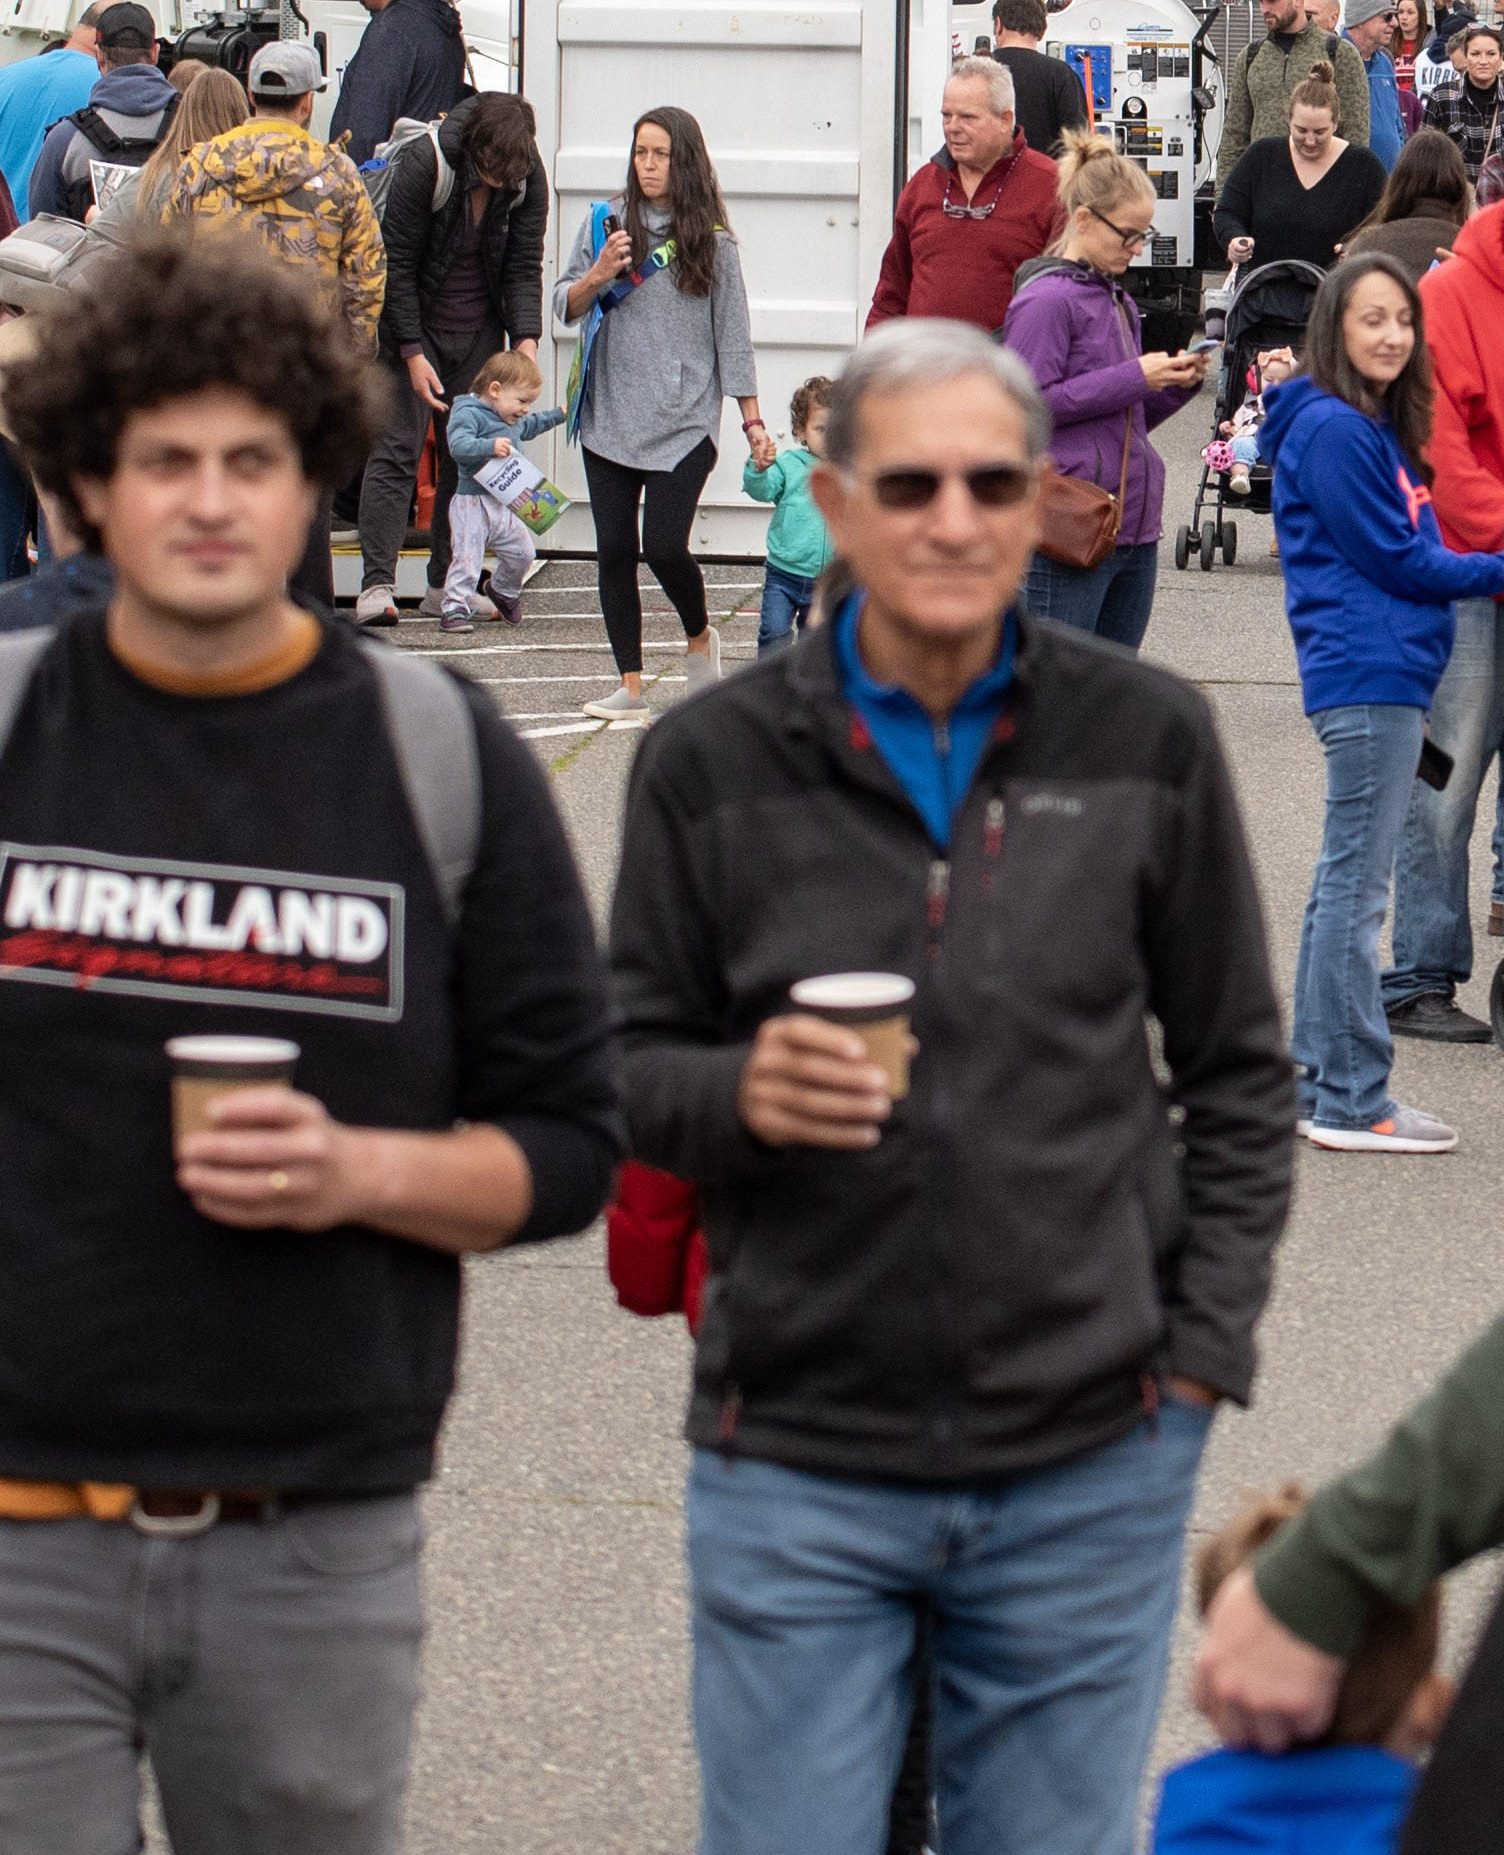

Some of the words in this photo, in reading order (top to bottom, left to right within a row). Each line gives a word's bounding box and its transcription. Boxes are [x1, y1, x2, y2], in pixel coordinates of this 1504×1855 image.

[489, 459, 519, 488] Recycling
[498, 468, 522, 491] Guide
[4, 862, 388, 964] KIRKLAND
